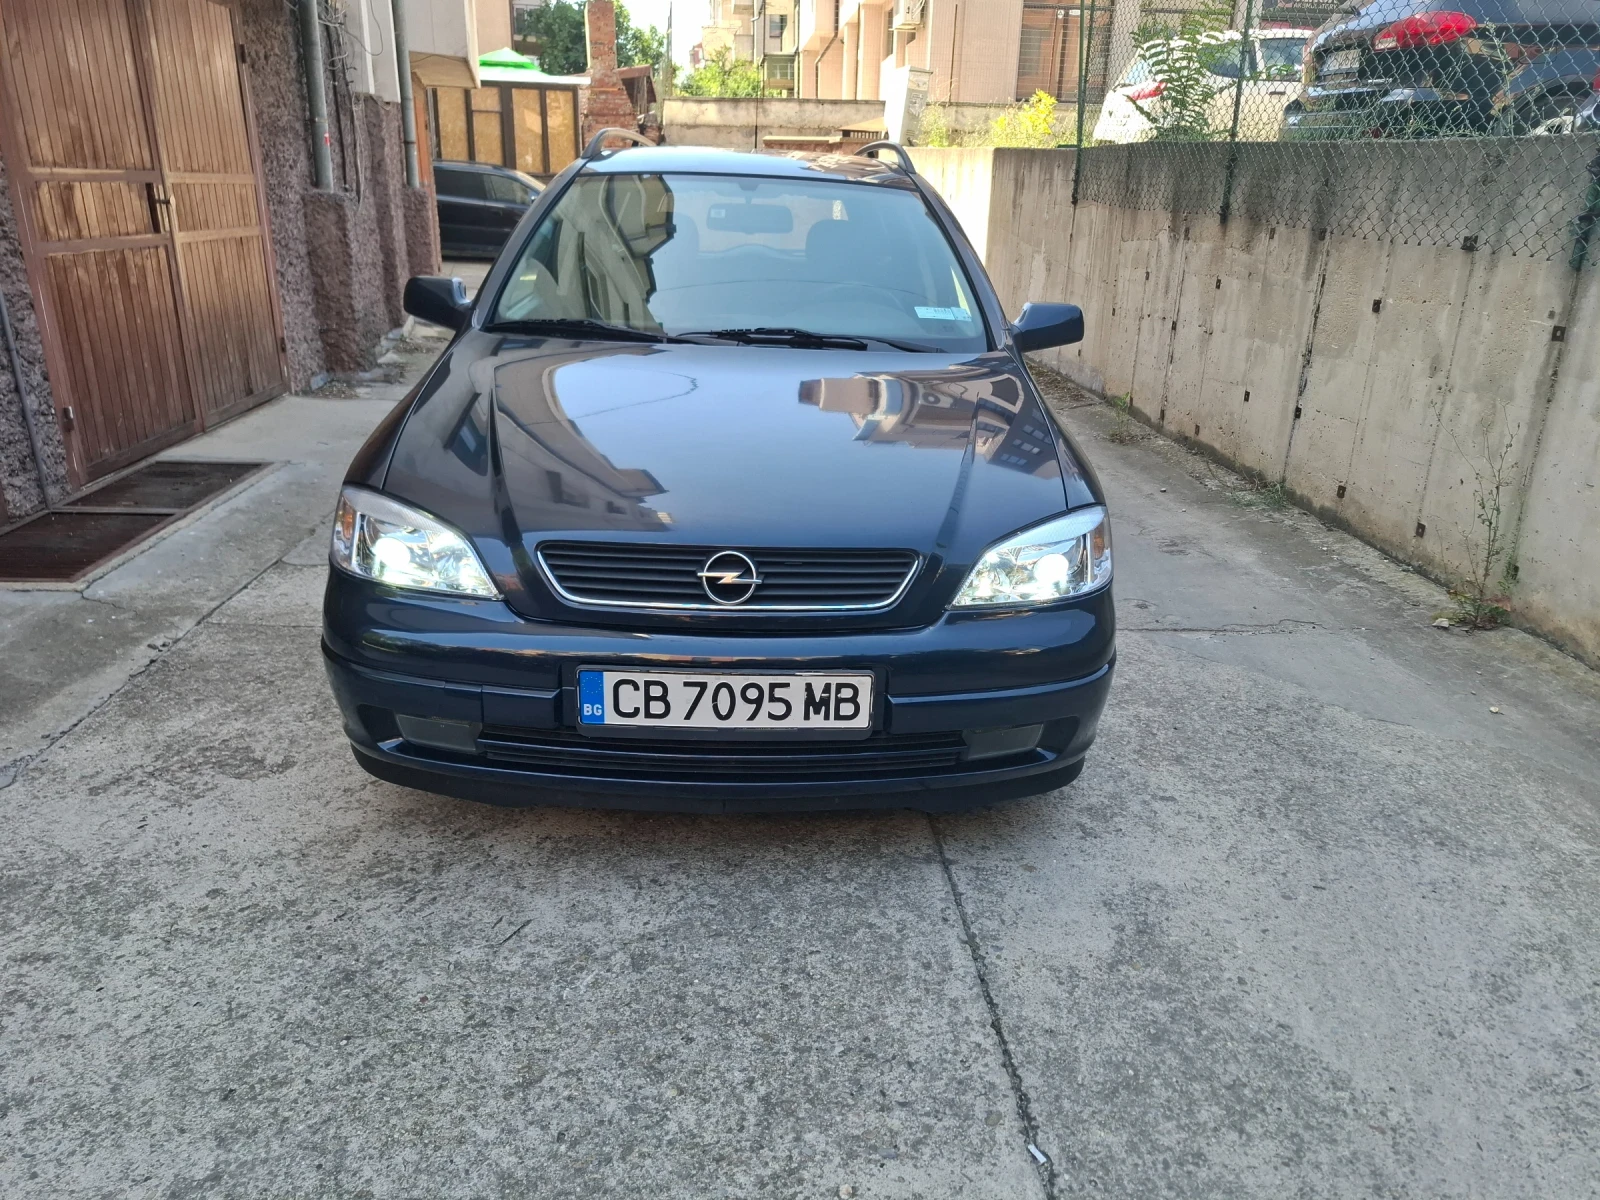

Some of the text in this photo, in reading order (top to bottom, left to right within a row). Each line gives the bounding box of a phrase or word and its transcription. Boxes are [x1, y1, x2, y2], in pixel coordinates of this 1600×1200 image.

[583, 703, 602, 716] BG
[612, 678, 861, 721] CB 7095 MB
